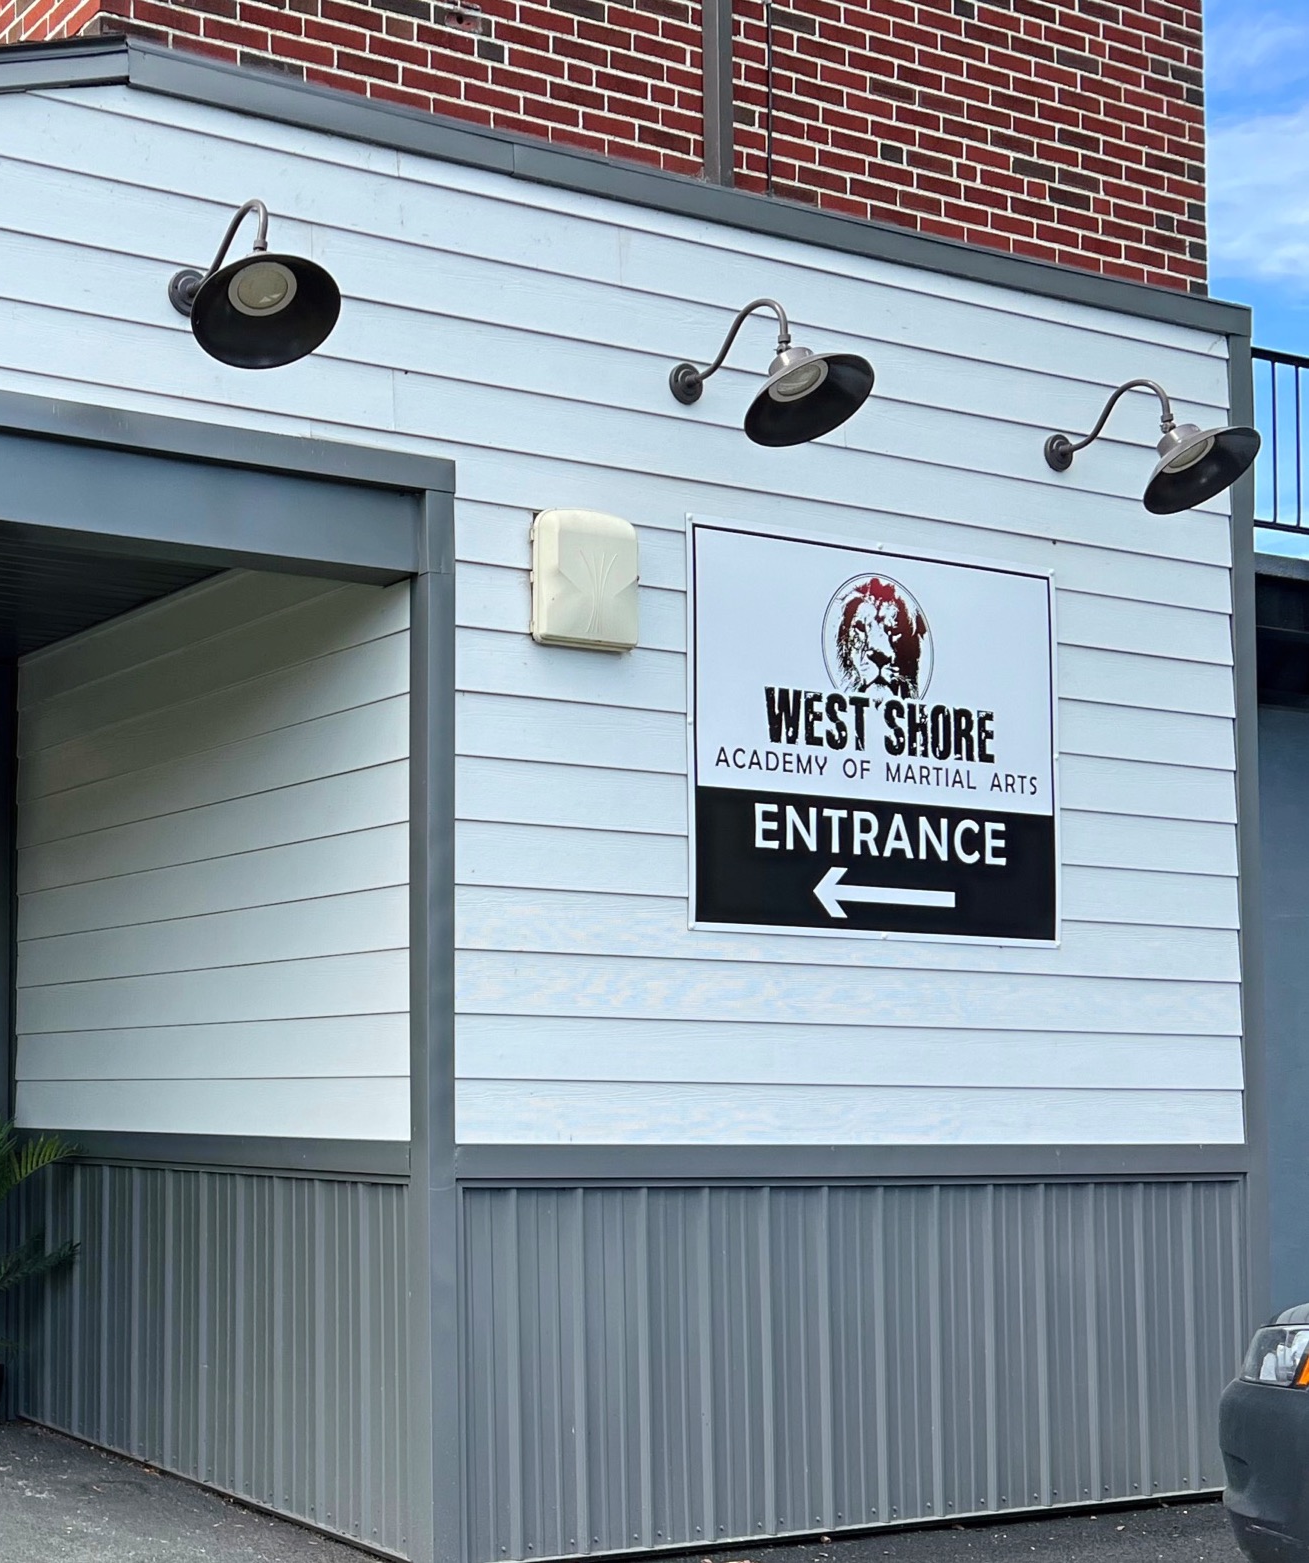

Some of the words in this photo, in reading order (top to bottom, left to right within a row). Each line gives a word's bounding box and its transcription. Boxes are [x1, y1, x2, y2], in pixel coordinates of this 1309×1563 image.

[764, 686, 870, 752] WEST
[883, 698, 995, 765] SHORE
[715, 746, 828, 776] ACADEMY
[842, 758, 871, 780] OF
[885, 762, 977, 790] MARTIAL
[990, 772, 1038, 796] ARTS
[754, 802, 1008, 867] ENTRANCE
